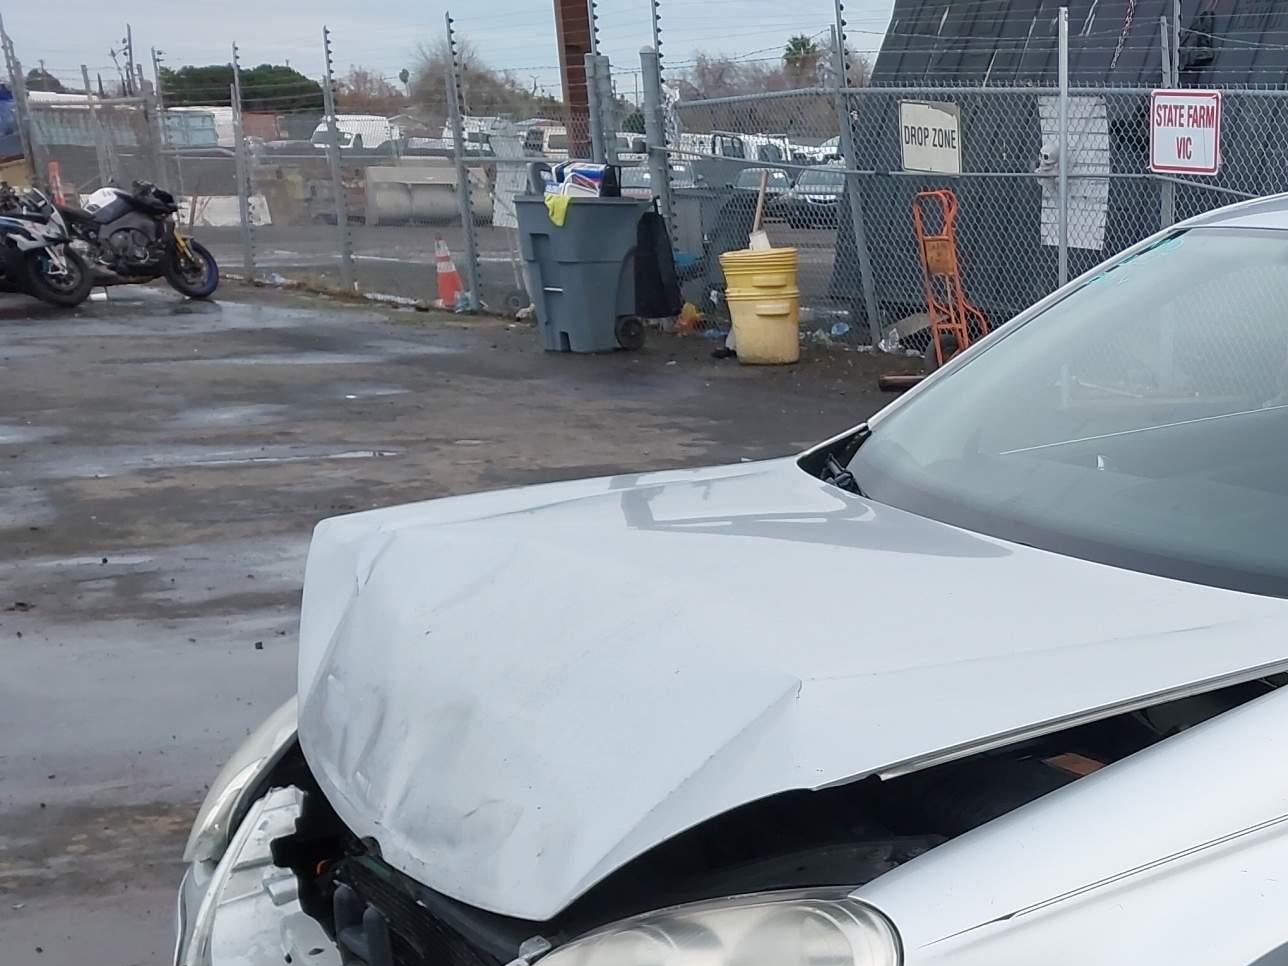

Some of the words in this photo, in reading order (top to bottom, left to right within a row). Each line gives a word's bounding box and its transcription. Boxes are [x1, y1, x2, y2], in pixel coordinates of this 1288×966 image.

[1156, 104, 1185, 128] STATE
[1187, 104, 1215, 129] FARM
[904, 125, 929, 147] DROP
[932, 127, 957, 149] ZONE
[1176, 136, 1193, 160] VIC
